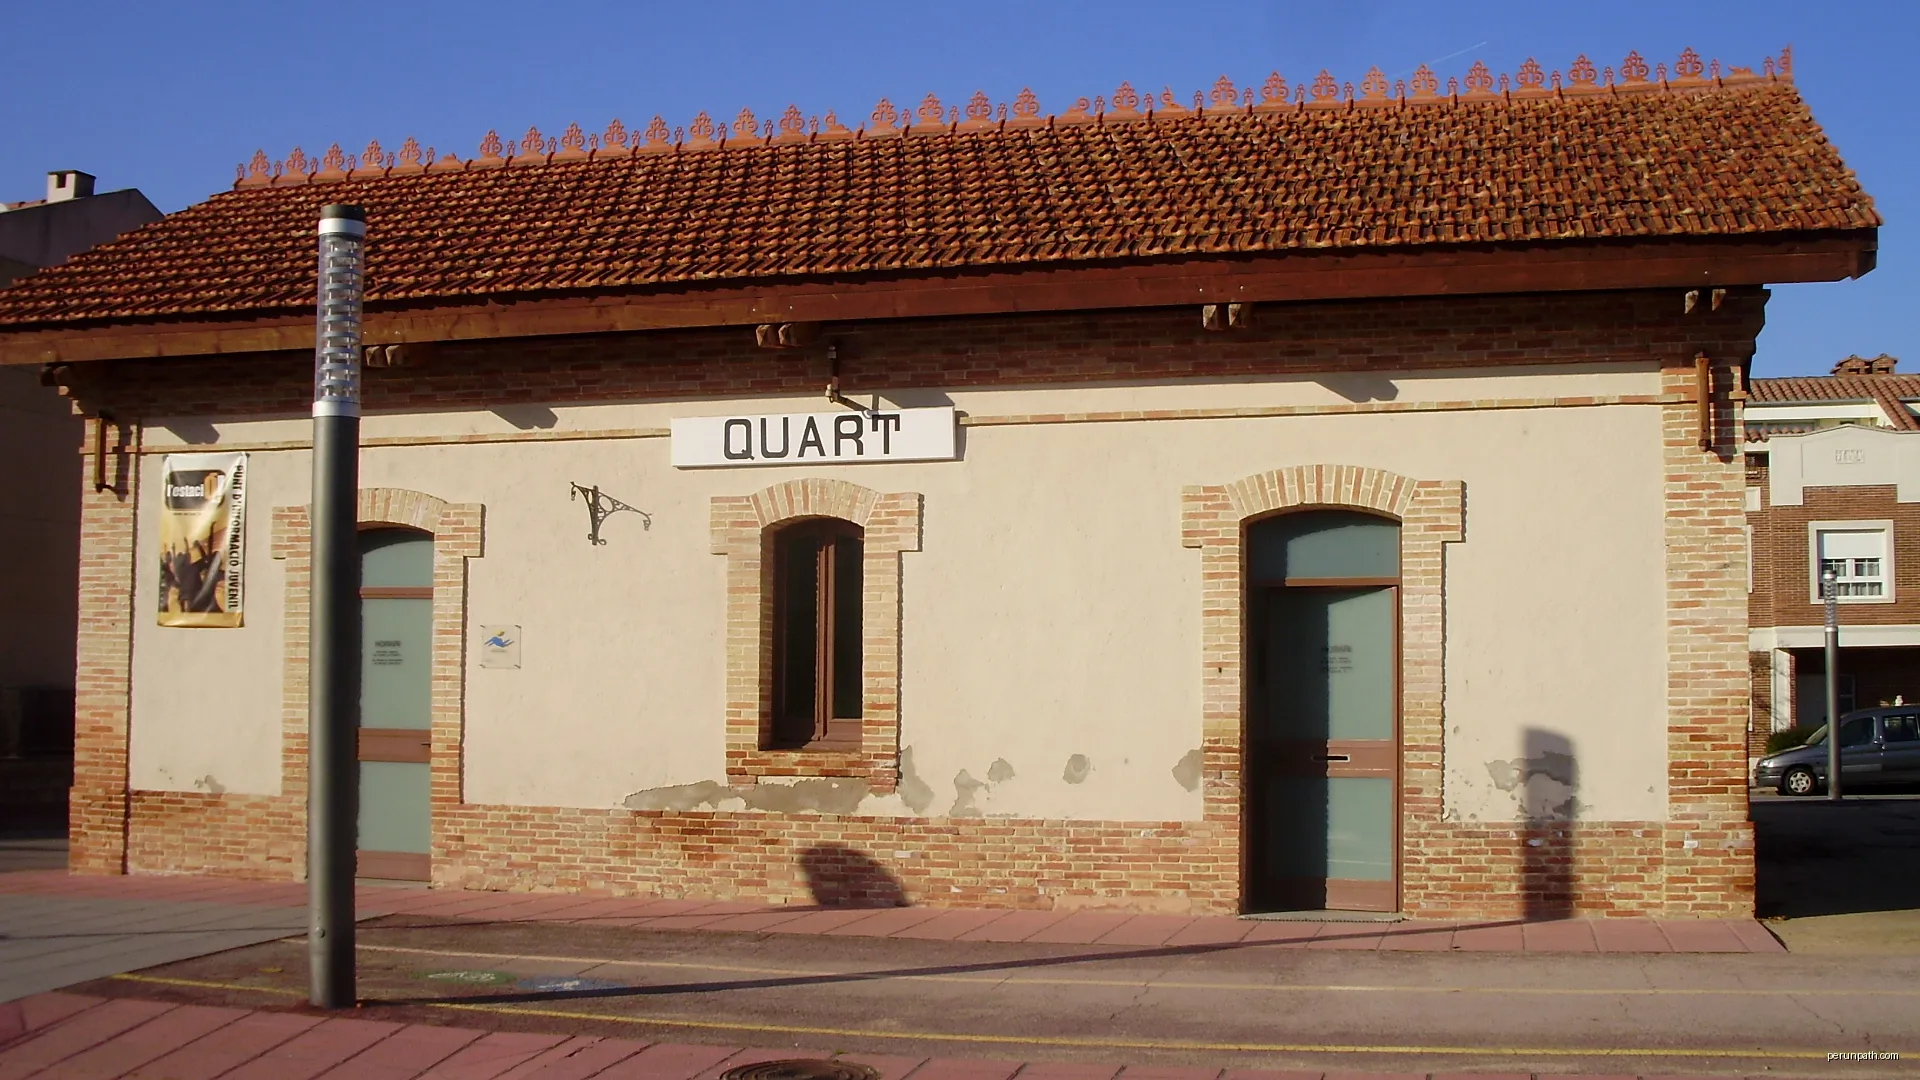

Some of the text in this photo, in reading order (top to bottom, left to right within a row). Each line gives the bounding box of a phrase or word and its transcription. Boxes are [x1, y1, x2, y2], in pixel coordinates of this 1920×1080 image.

[724, 413, 901, 460] QUART
[232, 465, 243, 490] PUNT
[228, 570, 239, 609] JUVENIL
